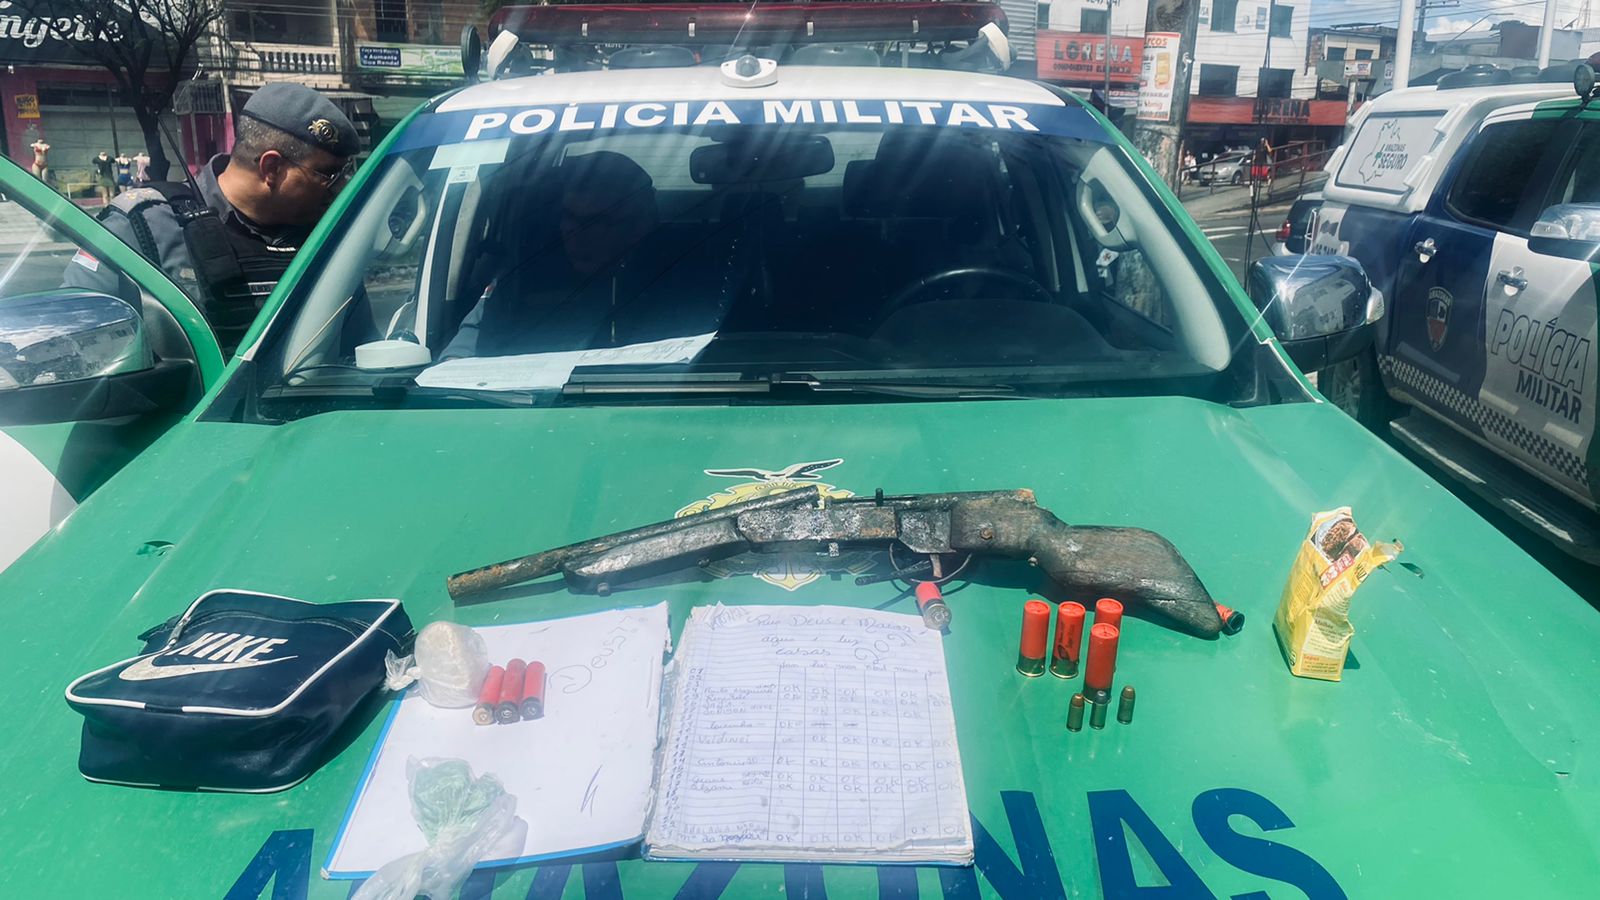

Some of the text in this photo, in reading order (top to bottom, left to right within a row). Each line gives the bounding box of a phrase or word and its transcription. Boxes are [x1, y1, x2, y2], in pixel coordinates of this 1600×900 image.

[1055, 40, 1132, 63] LORENA
[465, 98, 1040, 140] POLÍCIA MILITAR
[1378, 153, 1408, 170] SEGURO
[1490, 308, 1590, 395] POLÍCIA
[1515, 370, 1583, 425] MILITAR
[164, 632, 289, 663] NIKE
